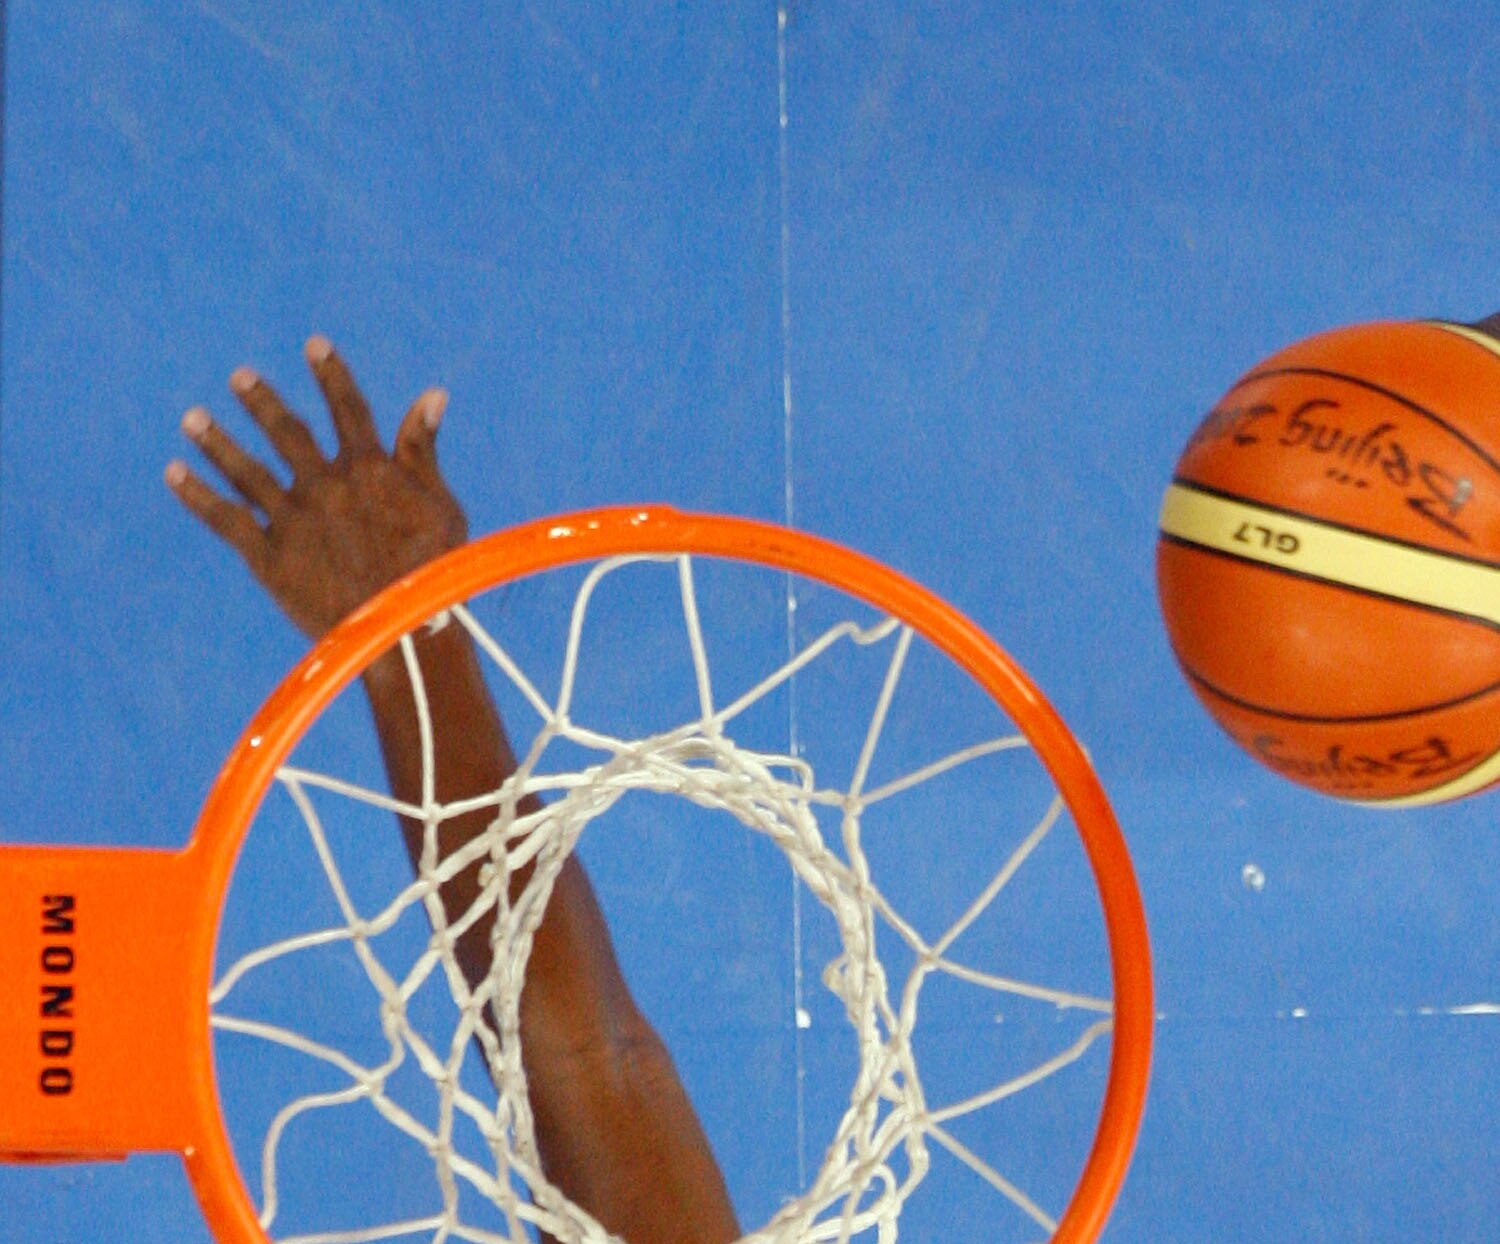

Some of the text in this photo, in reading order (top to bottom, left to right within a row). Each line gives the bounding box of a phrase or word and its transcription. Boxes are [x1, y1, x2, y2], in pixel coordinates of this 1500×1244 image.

[1231, 520, 1302, 556] GL7
[1282, 400, 1473, 543] Beijing
[40, 894, 76, 1097] MONDO
